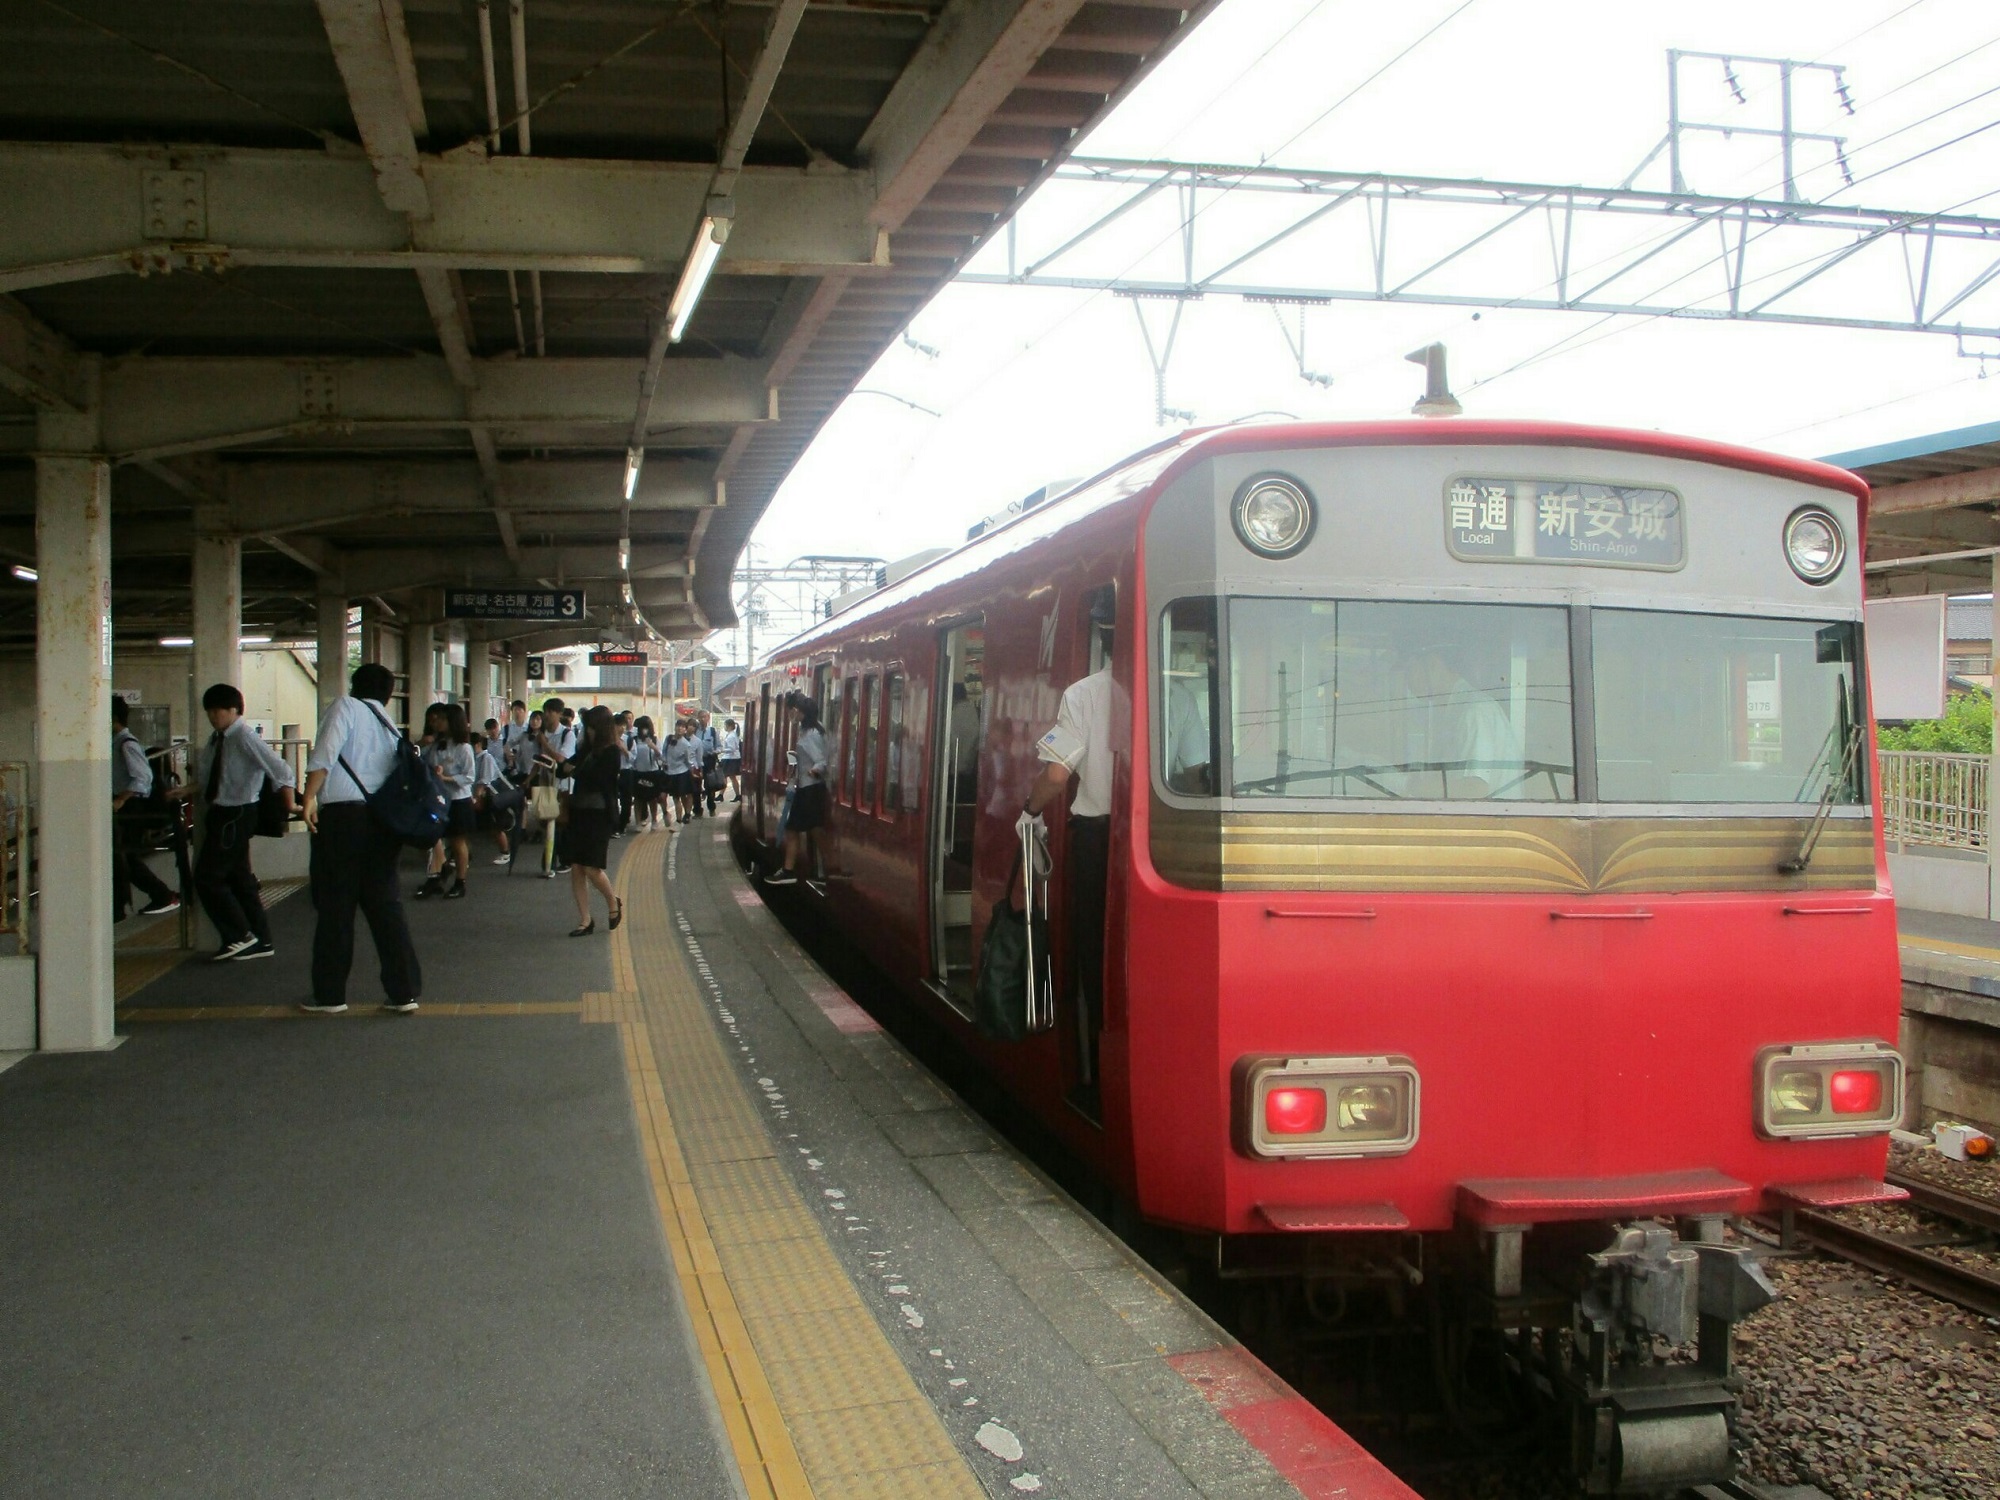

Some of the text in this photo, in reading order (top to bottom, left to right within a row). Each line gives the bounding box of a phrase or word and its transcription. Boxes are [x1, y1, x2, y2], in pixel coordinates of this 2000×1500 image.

[1451, 484, 1507, 530] 普通
[1539, 491, 1667, 540] 新安城
[1461, 532, 1494, 545] Local
[1570, 539, 1638, 556] Shin-Anjo
[532, 594, 555, 607] 方面
[562, 595, 576, 616] 3
[530, 661, 542, 676] 3
